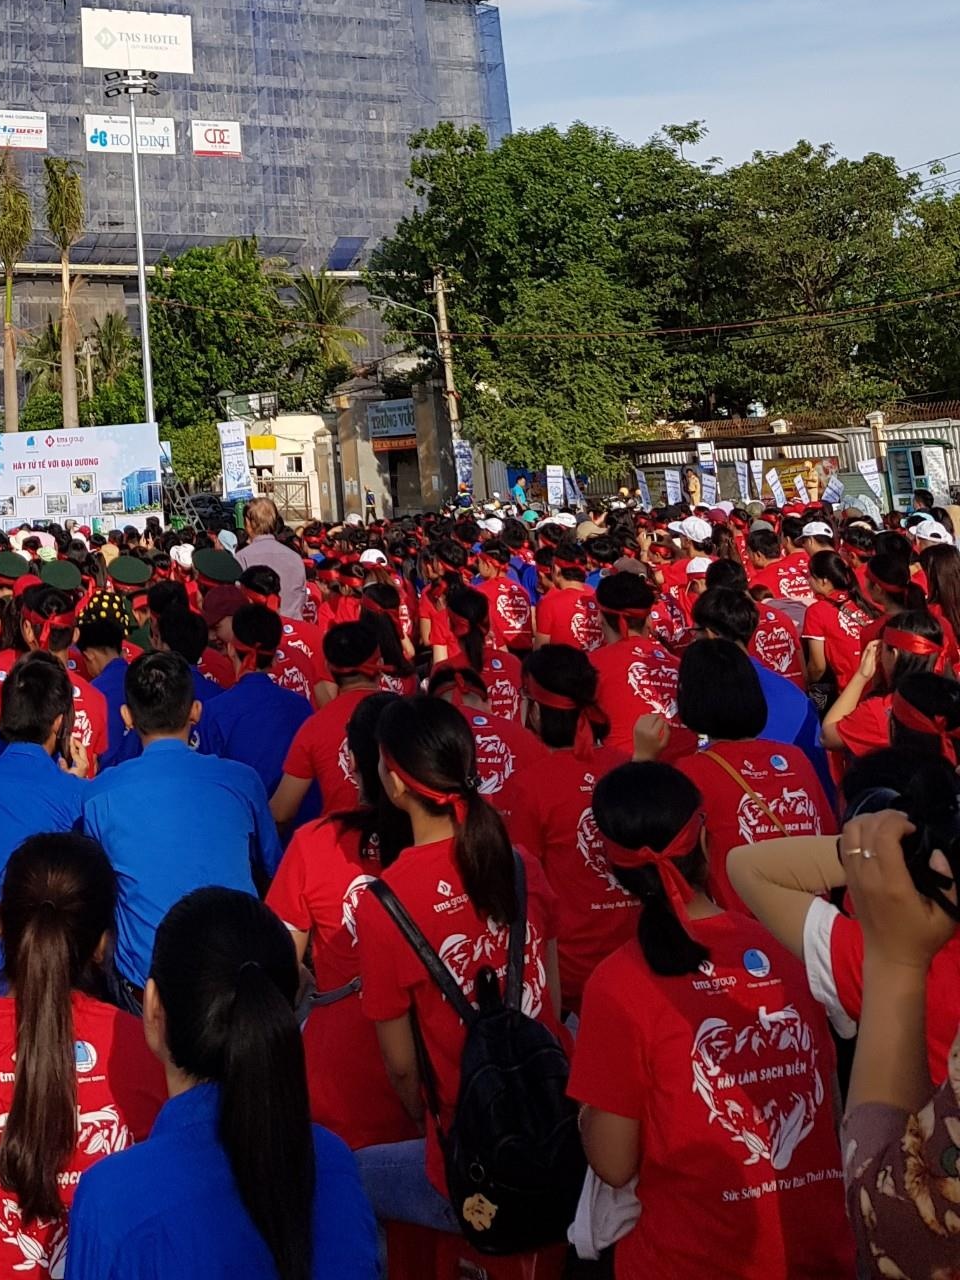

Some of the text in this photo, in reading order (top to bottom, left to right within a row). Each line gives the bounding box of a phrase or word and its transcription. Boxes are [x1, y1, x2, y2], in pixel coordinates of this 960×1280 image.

[118, 32, 180, 45] TMS HOTEL
[433, 893, 470, 913] tms group
[692, 980, 711, 990] tms
[712, 976, 737, 990] group
[0, 1071, 15, 1082] tm
[738, 1070, 758, 1085] LÀM
